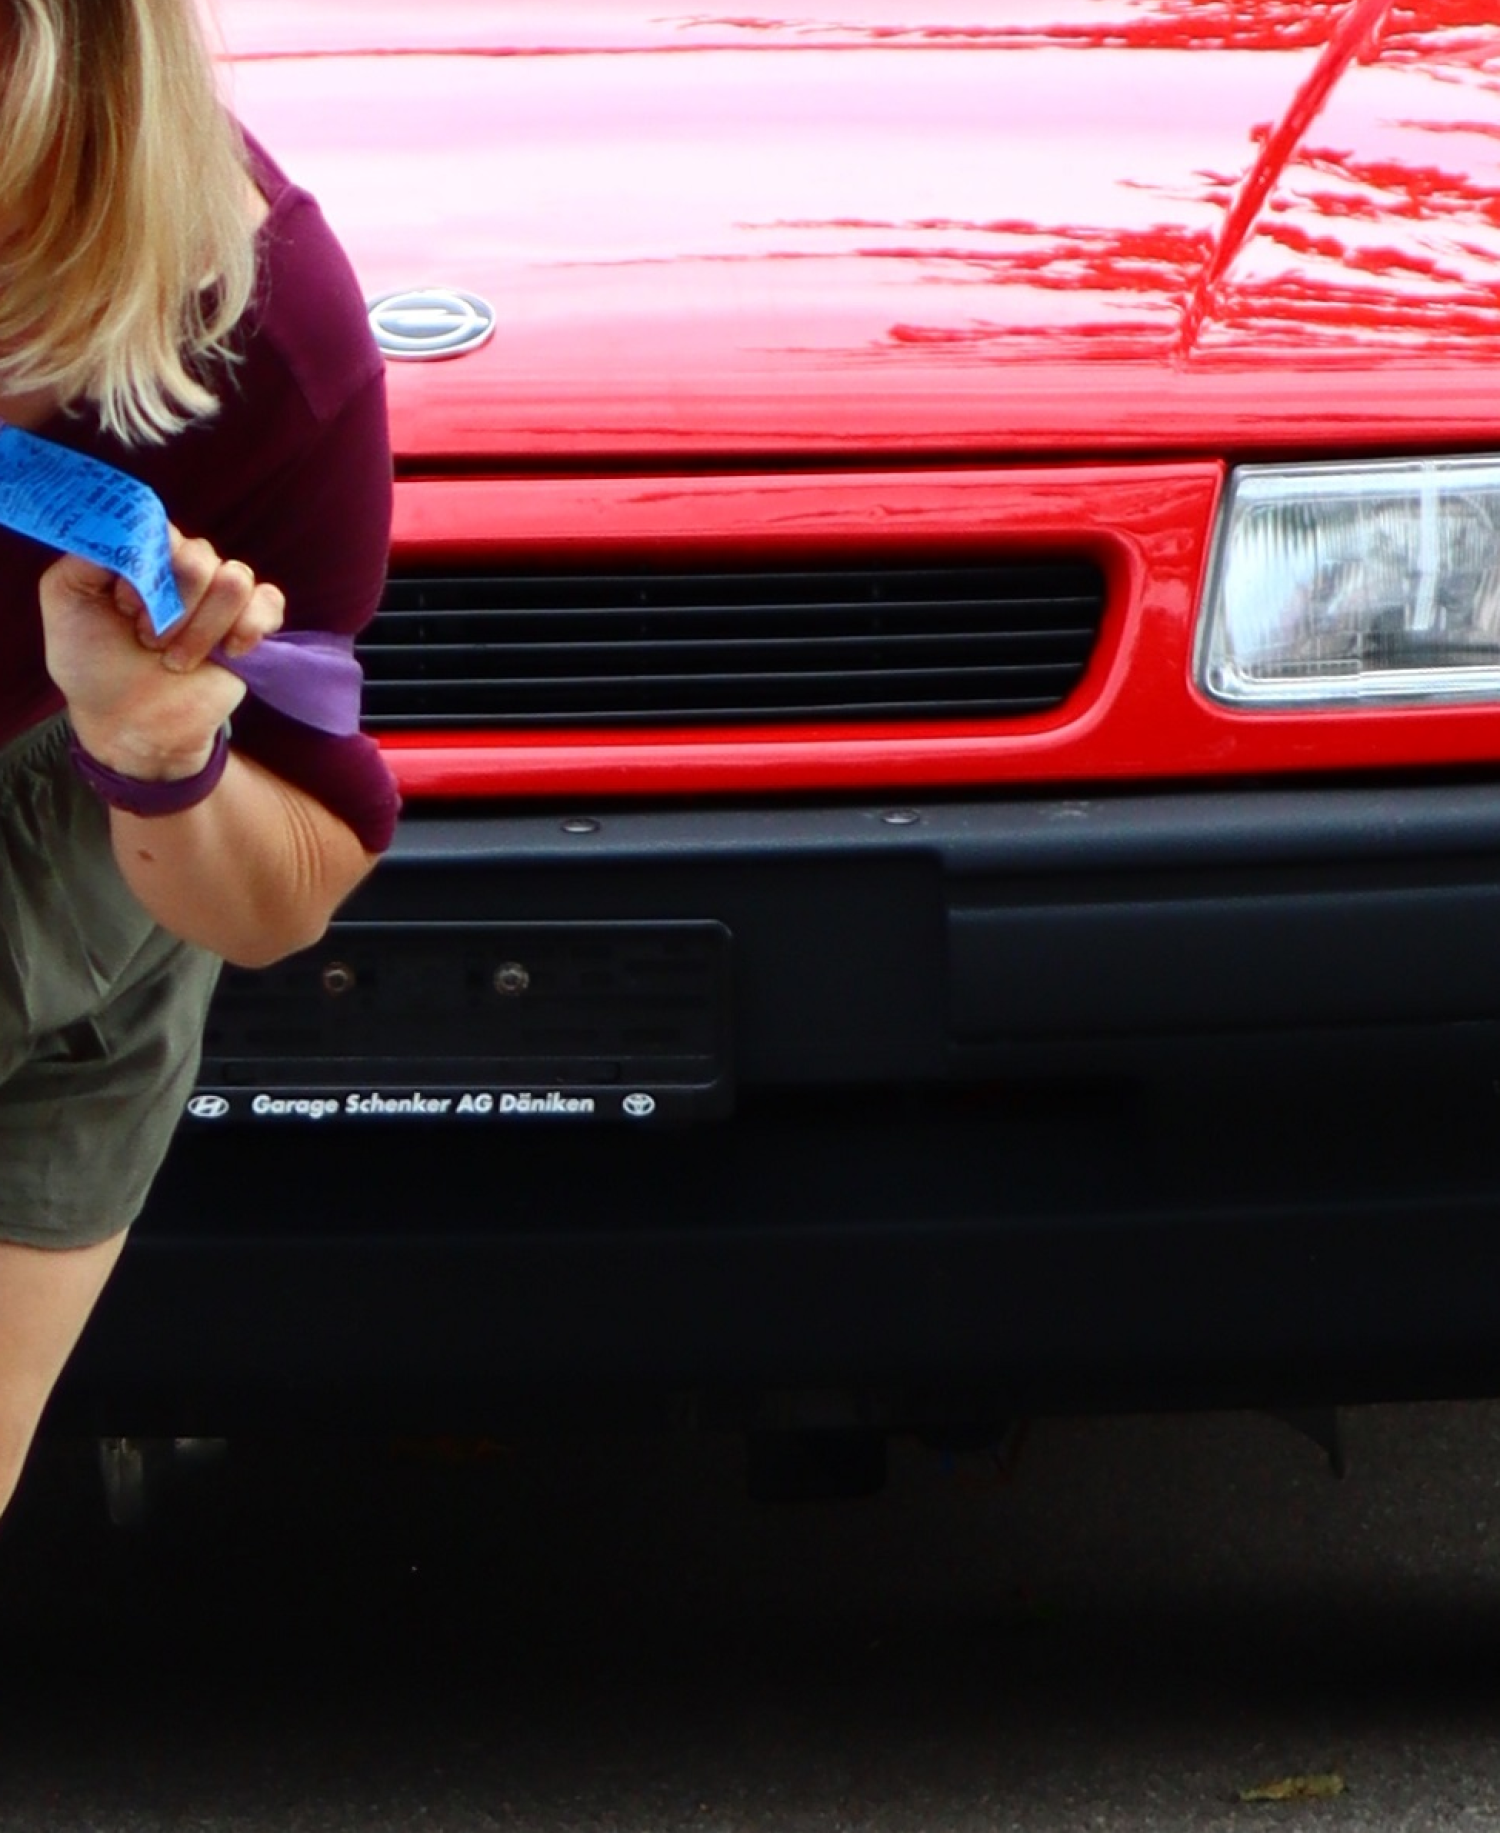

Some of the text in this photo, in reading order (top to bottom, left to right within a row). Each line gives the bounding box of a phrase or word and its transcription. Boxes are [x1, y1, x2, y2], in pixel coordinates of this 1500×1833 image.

[251, 1092, 595, 1119] Garage Schenker AG Däniken
